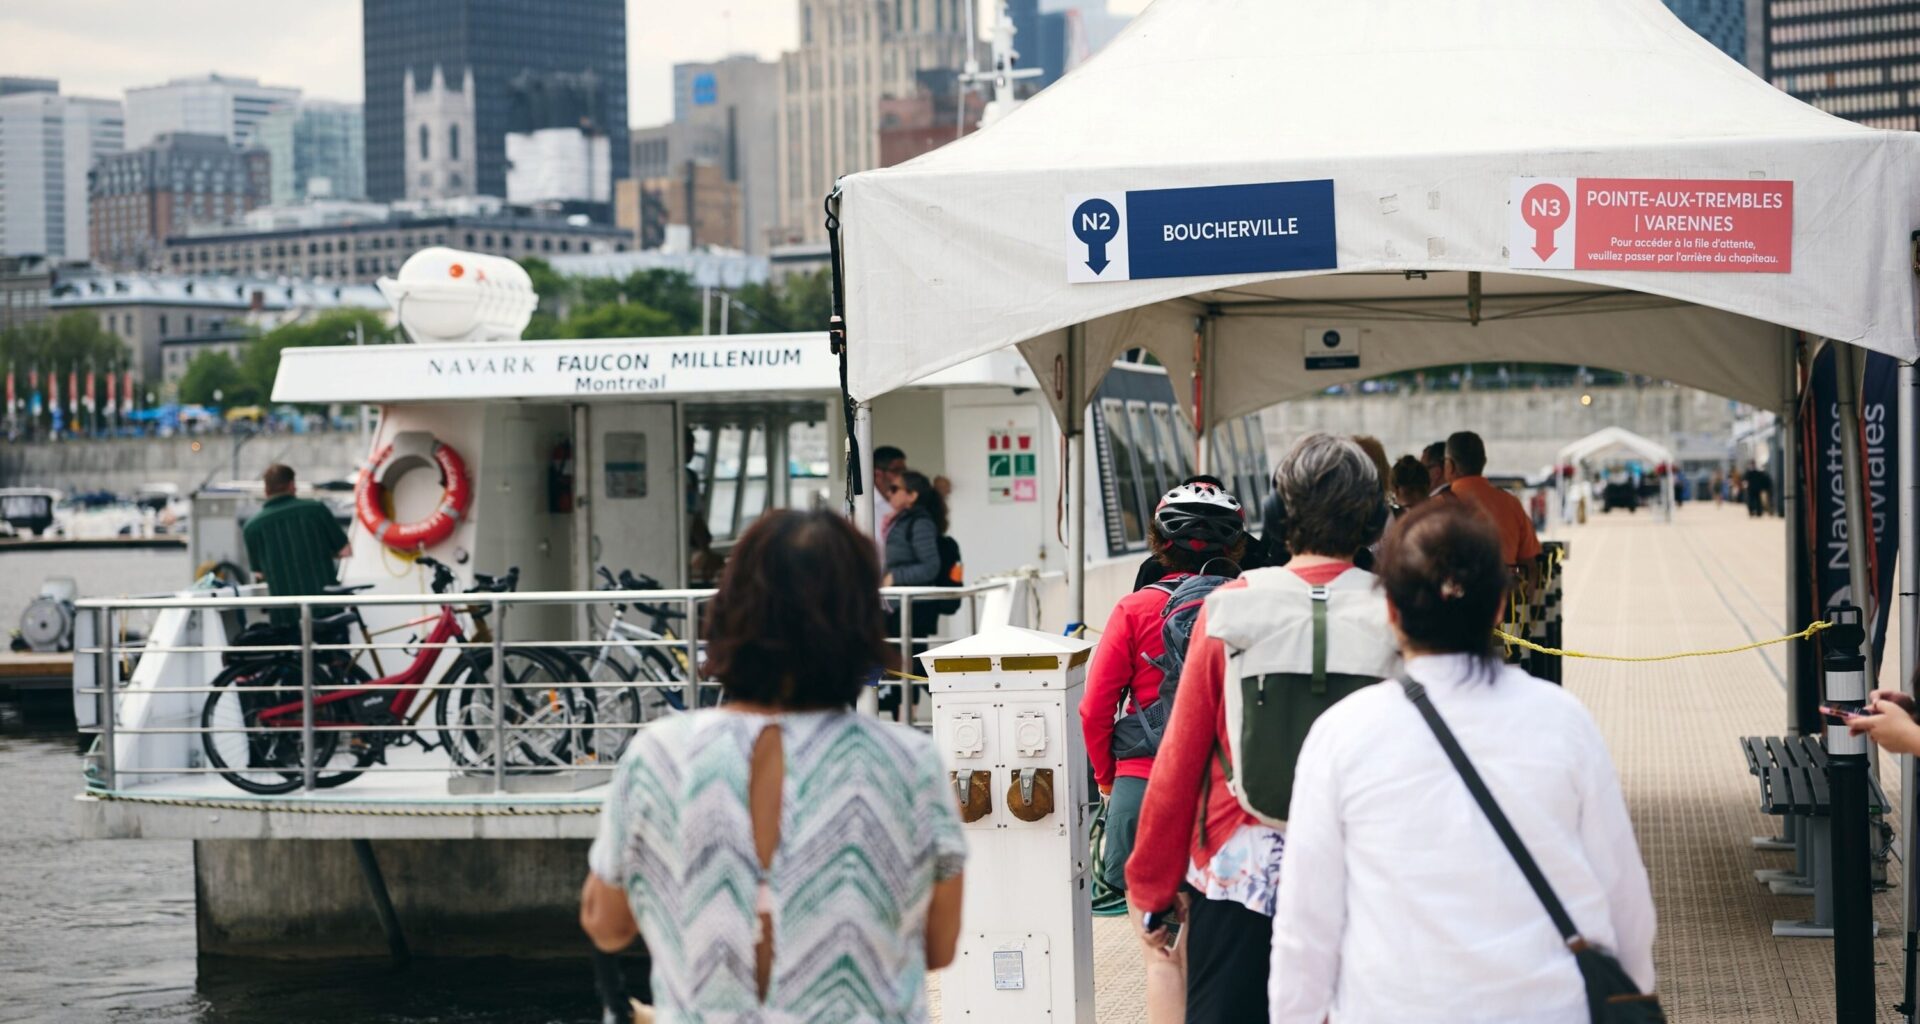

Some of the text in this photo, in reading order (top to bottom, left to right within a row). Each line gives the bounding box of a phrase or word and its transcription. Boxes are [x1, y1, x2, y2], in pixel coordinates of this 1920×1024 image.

[1531, 198, 1561, 217] N3
[1586, 190, 1783, 209] POINTE-AUX-TREMBLES
[1081, 212, 1111, 232] N2
[1163, 217, 1299, 242] BOUCHERVILLE
[1644, 215, 1733, 232] VARENNES
[1610, 236, 1632, 248] Pour
[1634, 237, 1673, 248] accéder
[1674, 237, 1682, 248] à
[1683, 237, 1693, 248] la
[1694, 237, 1710, 249] file
[1587, 250, 1623, 261] veuillez
[1624, 252, 1656, 263] passer
[1657, 253, 1675, 264] par
[1714, 252, 1727, 263] du
[1728, 252, 1779, 265] chapiteau.
[428, 348, 801, 375] NAVARK FAUCON MILLENIUM
[575, 373, 666, 392] Montreal
[1863, 402, 1887, 544] uviales
